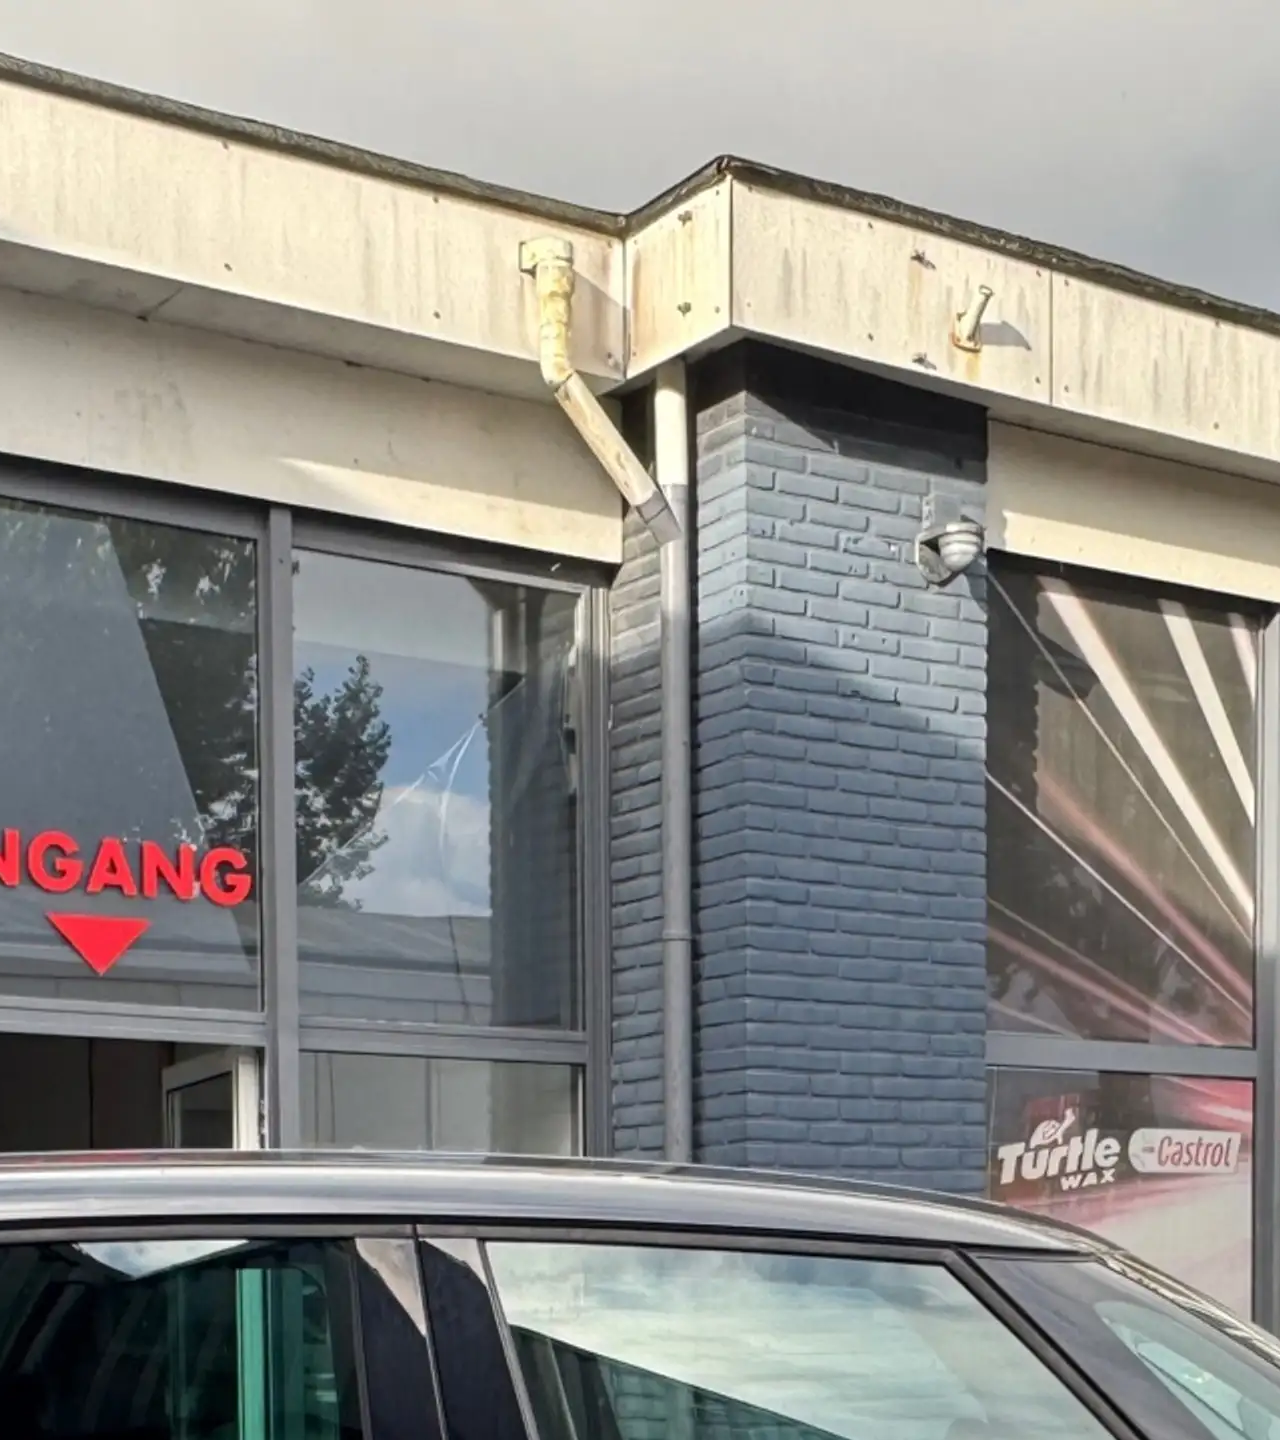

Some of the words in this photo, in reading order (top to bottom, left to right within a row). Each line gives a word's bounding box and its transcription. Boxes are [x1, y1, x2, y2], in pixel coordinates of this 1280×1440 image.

[997, 1128, 1121, 1185] Turtle
[1156, 1135, 1231, 1168] Castrol
[1060, 1168, 1117, 1191] WAX
